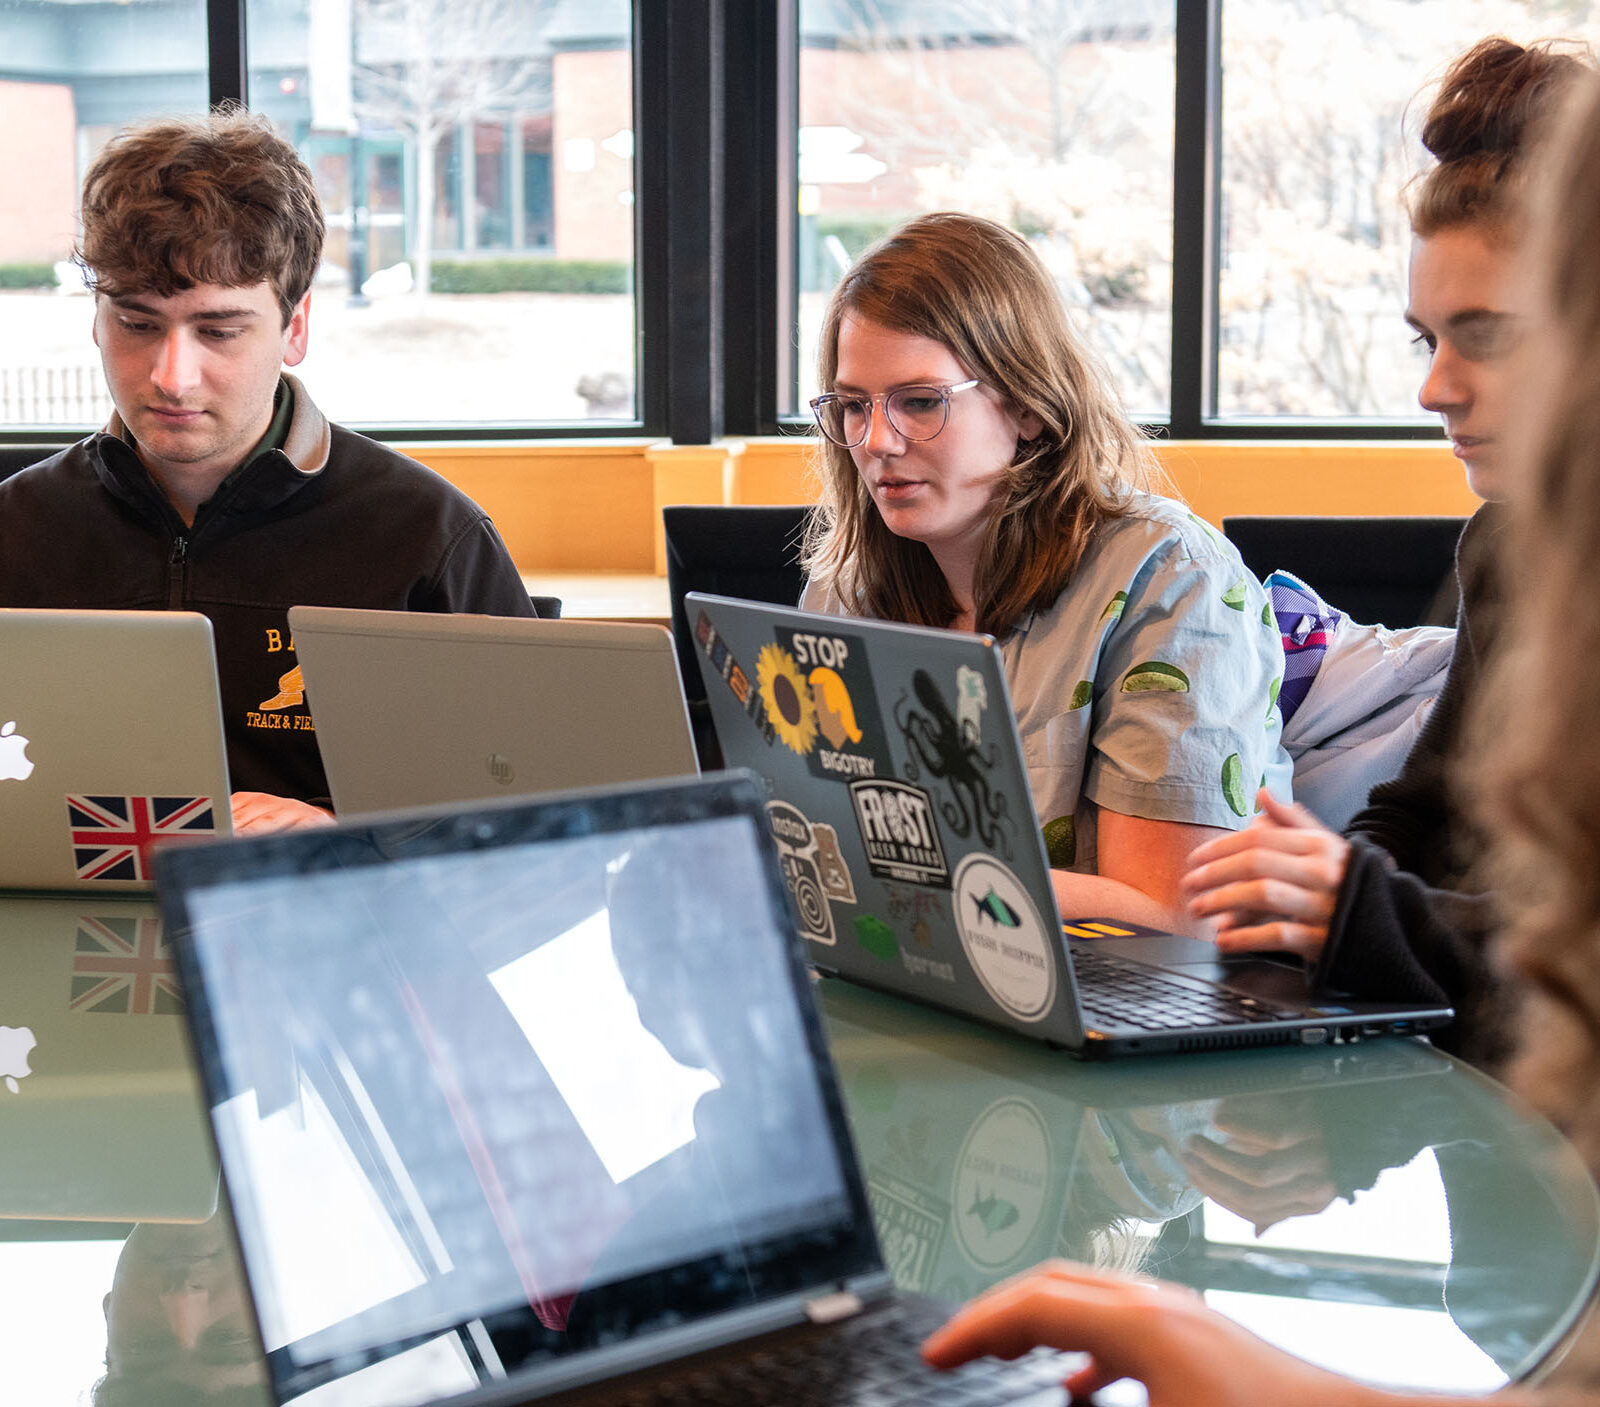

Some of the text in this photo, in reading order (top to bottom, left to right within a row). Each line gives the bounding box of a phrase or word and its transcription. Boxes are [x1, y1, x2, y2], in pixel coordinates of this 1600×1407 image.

[792, 633, 849, 669] STOP
[246, 711, 282, 729] TRACK
[819, 749, 876, 777] BIGOTRY
[857, 788, 932, 849] FROST
